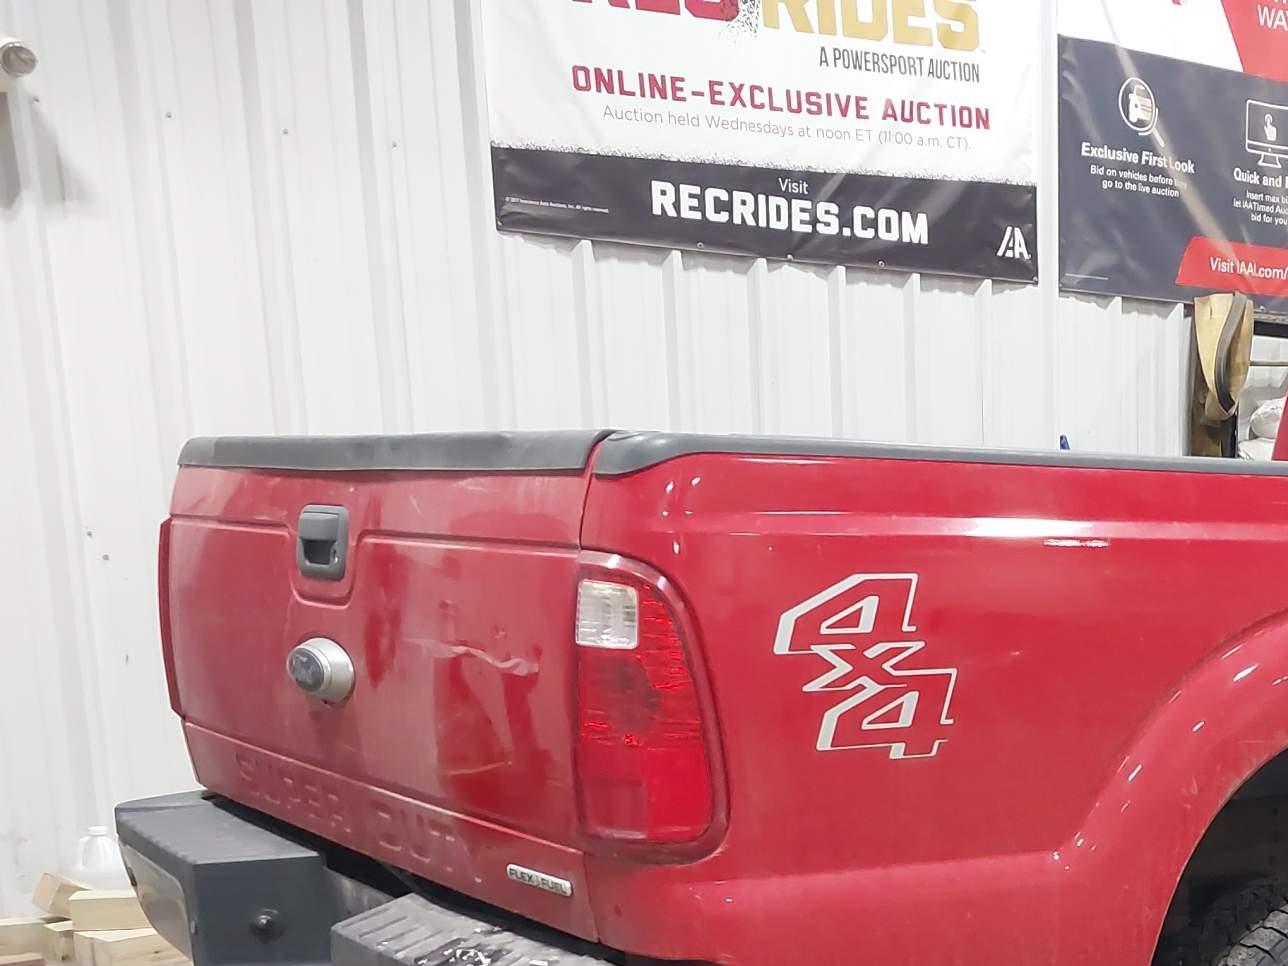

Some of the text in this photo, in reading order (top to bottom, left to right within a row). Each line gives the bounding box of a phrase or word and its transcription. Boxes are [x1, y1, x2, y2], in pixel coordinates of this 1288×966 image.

[819, 46, 980, 83] A POWERSPORT AUCTION
[571, 65, 990, 130] ONLINE-EXCLUSIVE AUCTION
[603, 104, 972, 151] Auction held Wednesdays at noon ET (11:00 a.m. CT).
[1081, 141, 1139, 164] Exclusive
[1141, 150, 1168, 169] First
[1090, 164, 1105, 176] Bid
[1106, 168, 1117, 177] on
[1119, 168, 1148, 182] vehicles
[1148, 173, 1176, 186] before
[1233, 167, 1260, 185] Quick
[1262, 175, 1282, 188] and
[778, 177, 809, 195] Visit
[1102, 179, 1180, 198] go to the live auction
[1246, 189, 1264, 202] Insert
[650, 179, 929, 245] RECRIDES.COM
[1250, 212, 1288, 226] bid for you
[1209, 256, 1234, 274] Visit
[508, 867, 534, 883] FLEX
